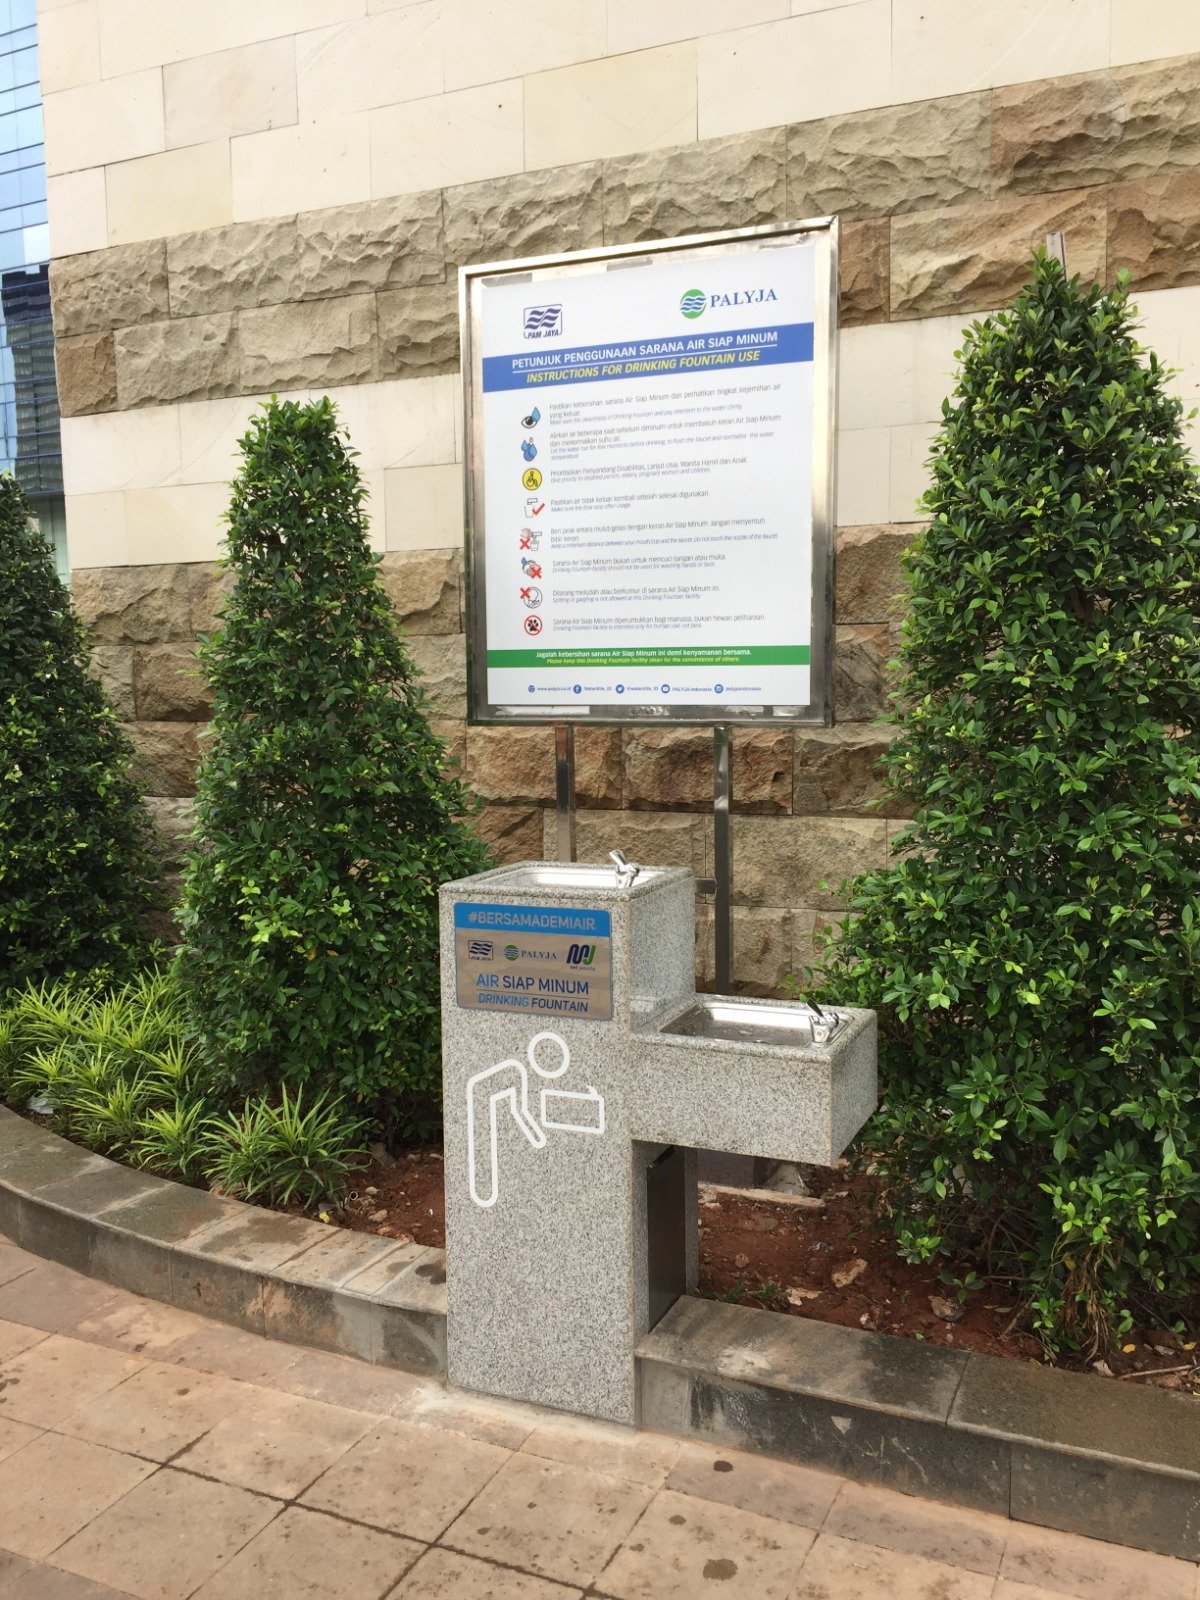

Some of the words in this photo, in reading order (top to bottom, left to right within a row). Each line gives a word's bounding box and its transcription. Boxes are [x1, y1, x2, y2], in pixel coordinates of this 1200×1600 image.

[710, 288, 778, 308] PALYJA
[527, 330, 541, 340] PAM
[542, 328, 560, 338] JAYA
[512, 354, 562, 369] PETUNJUK
[564, 348, 636, 364] PENGGUNAAN
[639, 342, 684, 357] SARANA
[687, 339, 706, 351] AIR
[708, 335, 733, 349] SIAP
[736, 331, 778, 346] MINUM
[527, 366, 599, 383] INSTRUCTIONS
[602, 364, 622, 376] FOR
[625, 358, 677, 374] DRINKING
[680, 354, 735, 369] FOUNTAIN
[738, 350, 760, 363] USE
[536, 651, 557, 659] Jagalah
[623, 650, 634, 658] Siap
[683, 649, 722, 657] kenyamanan
[468, 911, 595, 930] #BERSAMADEMIAIR
[522, 950, 557, 960] PALYJA
[476, 974, 499, 987] AIR
[503, 976, 534, 989] SIAP
[539, 978, 589, 995] MINUM
[478, 994, 529, 1006] DRINKING
[531, 998, 588, 1012] FOUNTAIN
